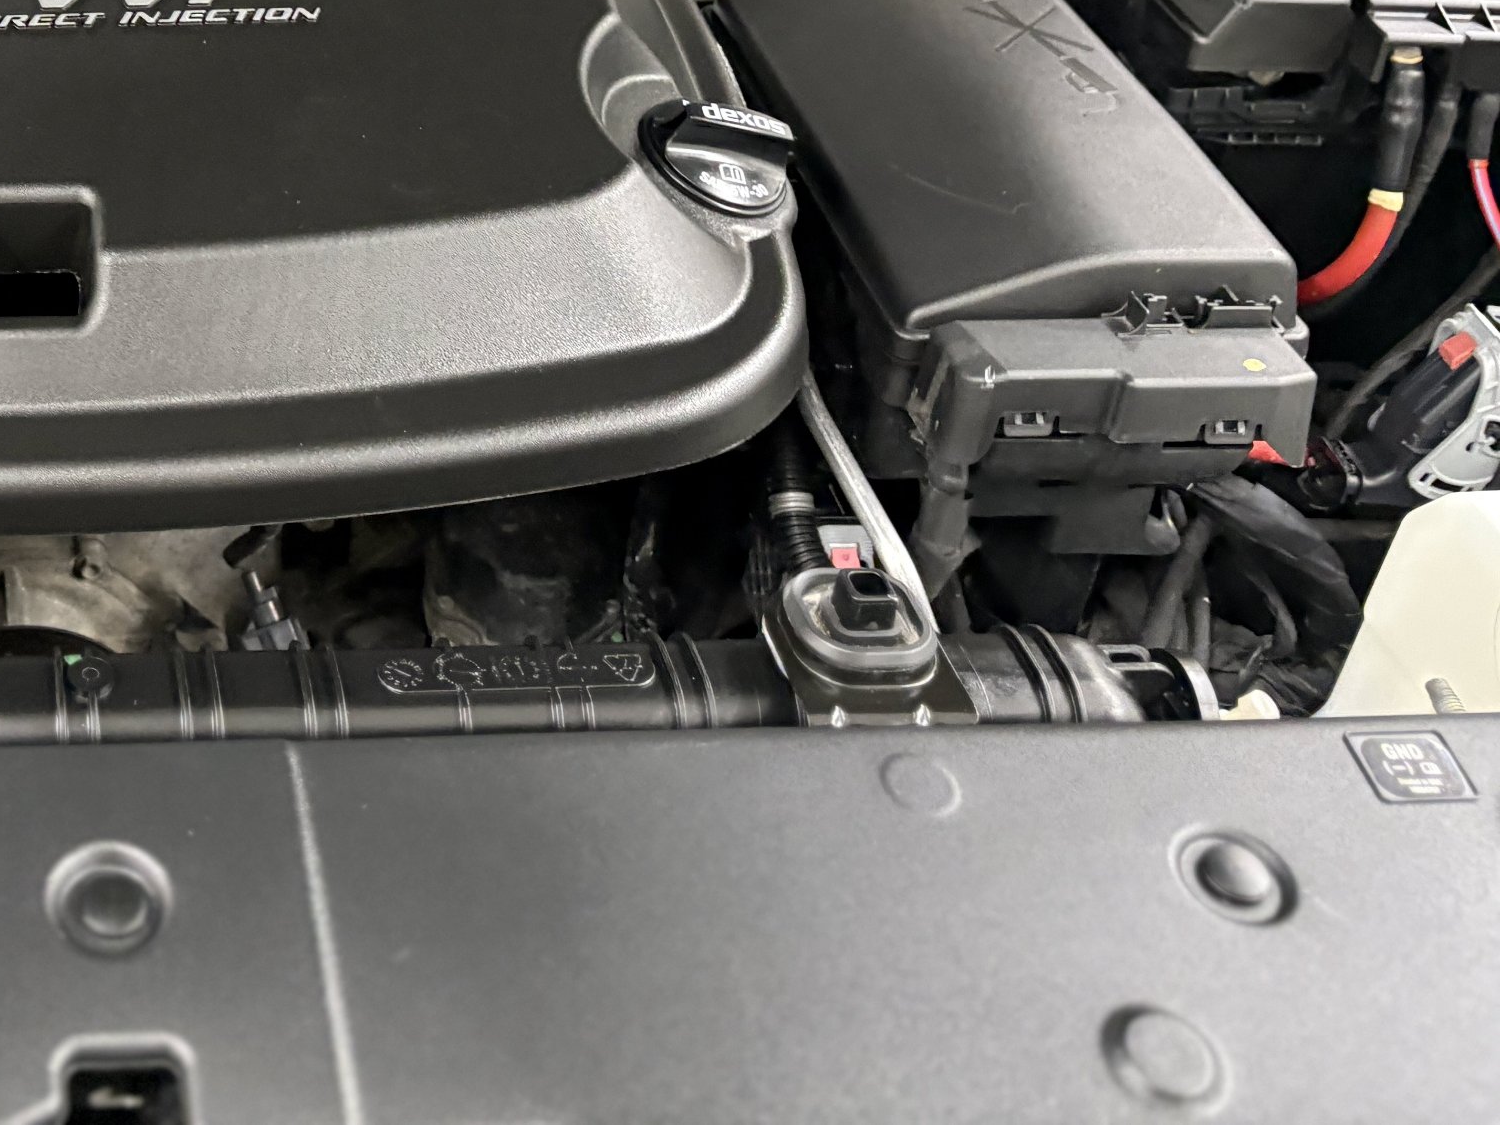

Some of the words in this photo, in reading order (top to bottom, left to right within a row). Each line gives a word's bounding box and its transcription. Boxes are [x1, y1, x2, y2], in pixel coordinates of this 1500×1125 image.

[118, 7, 321, 27] INJECTION
[701, 102, 787, 135] dexos
[1381, 743, 1425, 760] GND
